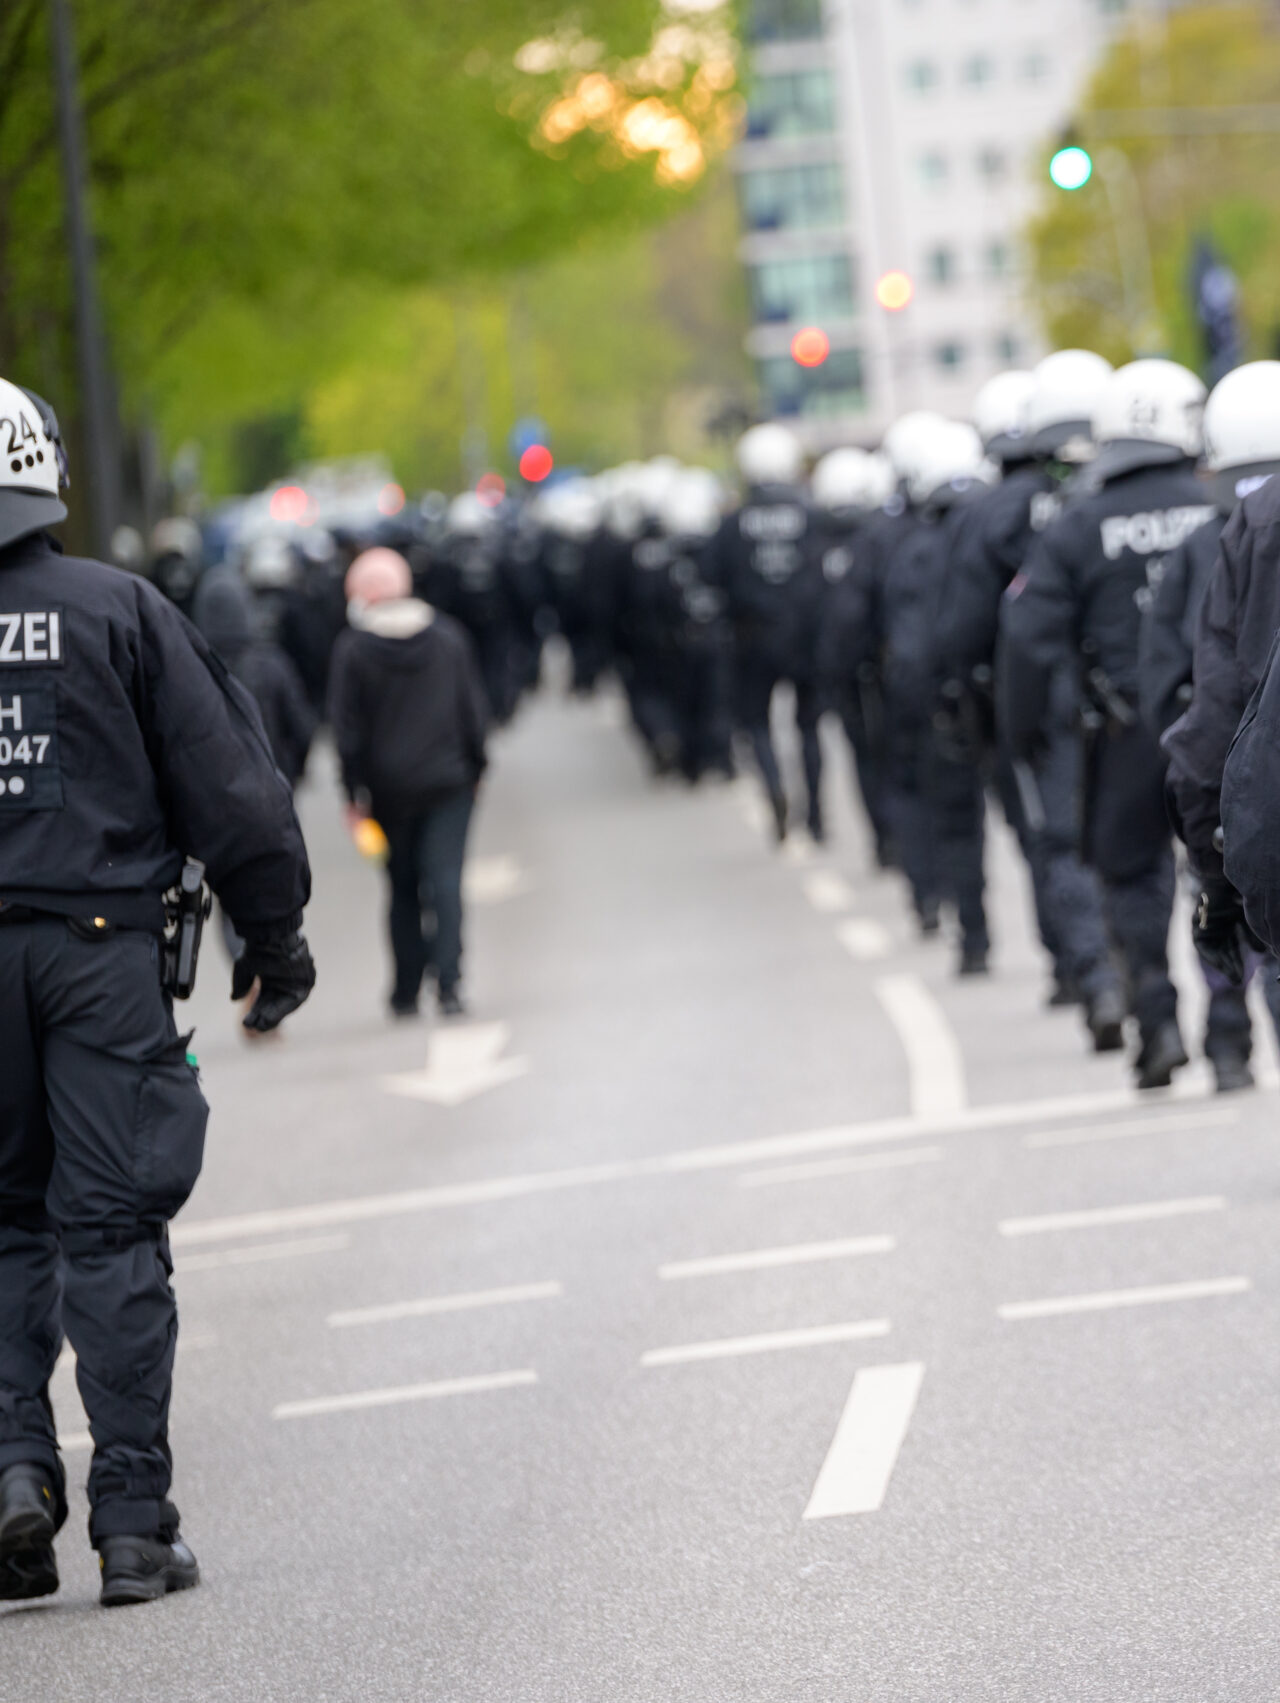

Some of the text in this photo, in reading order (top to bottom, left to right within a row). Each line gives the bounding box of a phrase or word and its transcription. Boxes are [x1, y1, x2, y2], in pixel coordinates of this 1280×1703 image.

[0, 411, 37, 454] 24
[0, 612, 60, 662] ZEI
[0, 735, 50, 766] 047
